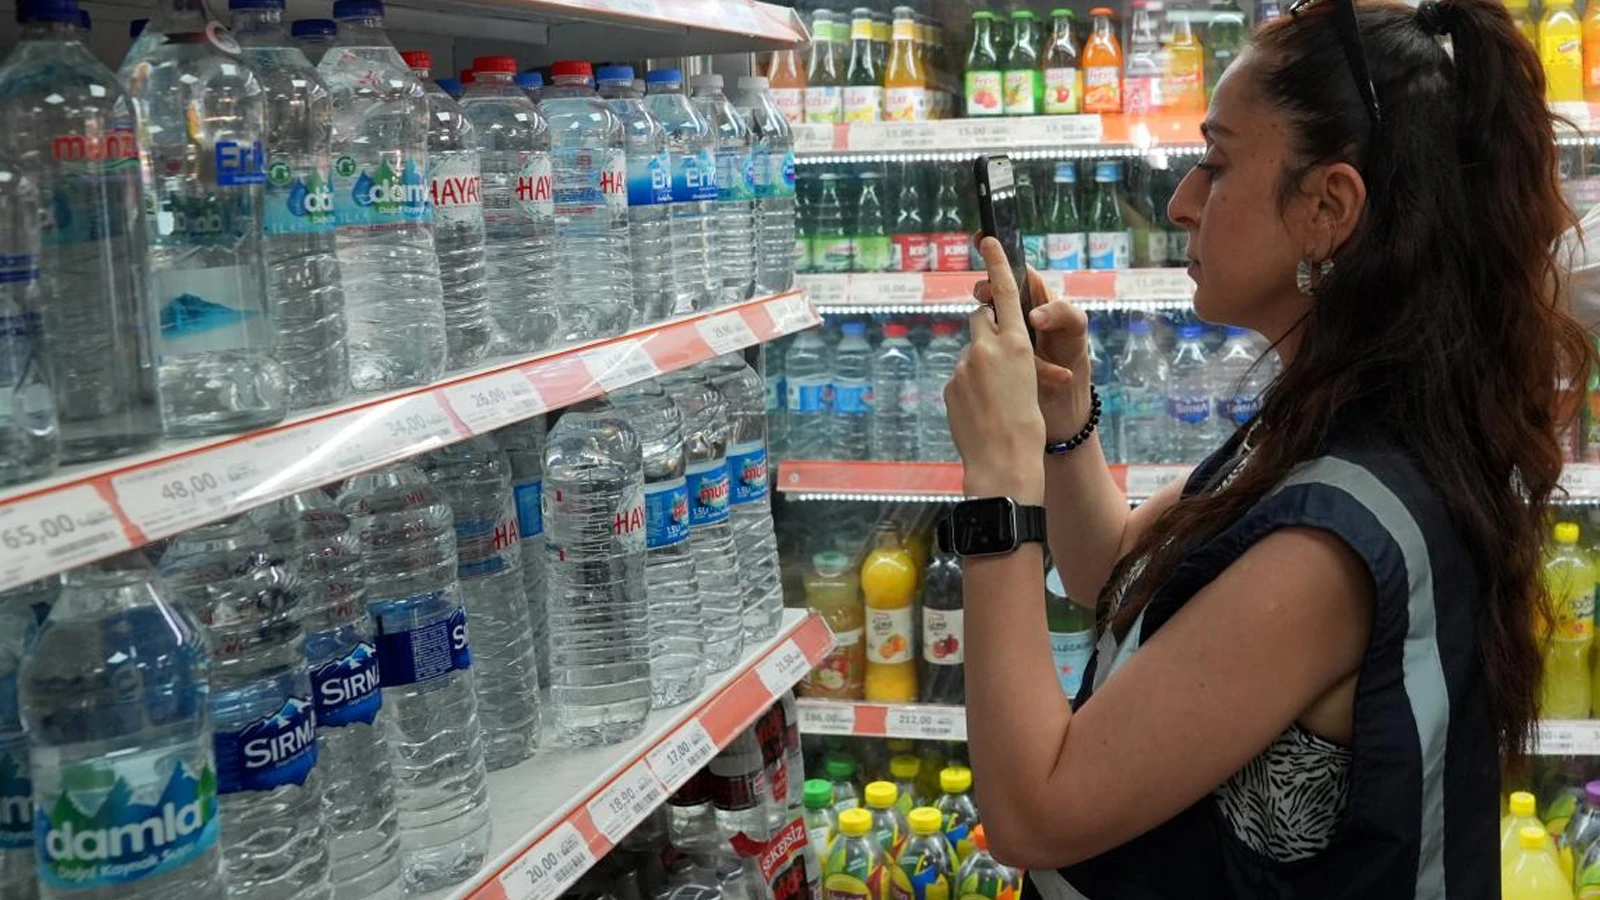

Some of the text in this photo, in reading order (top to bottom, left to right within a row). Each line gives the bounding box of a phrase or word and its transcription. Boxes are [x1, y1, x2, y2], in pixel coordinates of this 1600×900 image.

[162, 472, 218, 501] 48,00
[2, 514, 76, 550] 65,00
[666, 741, 690, 765] 17,00
[609, 787, 636, 815] 18,90
[46, 801, 203, 861] damla
[526, 852, 558, 884] 20,00
